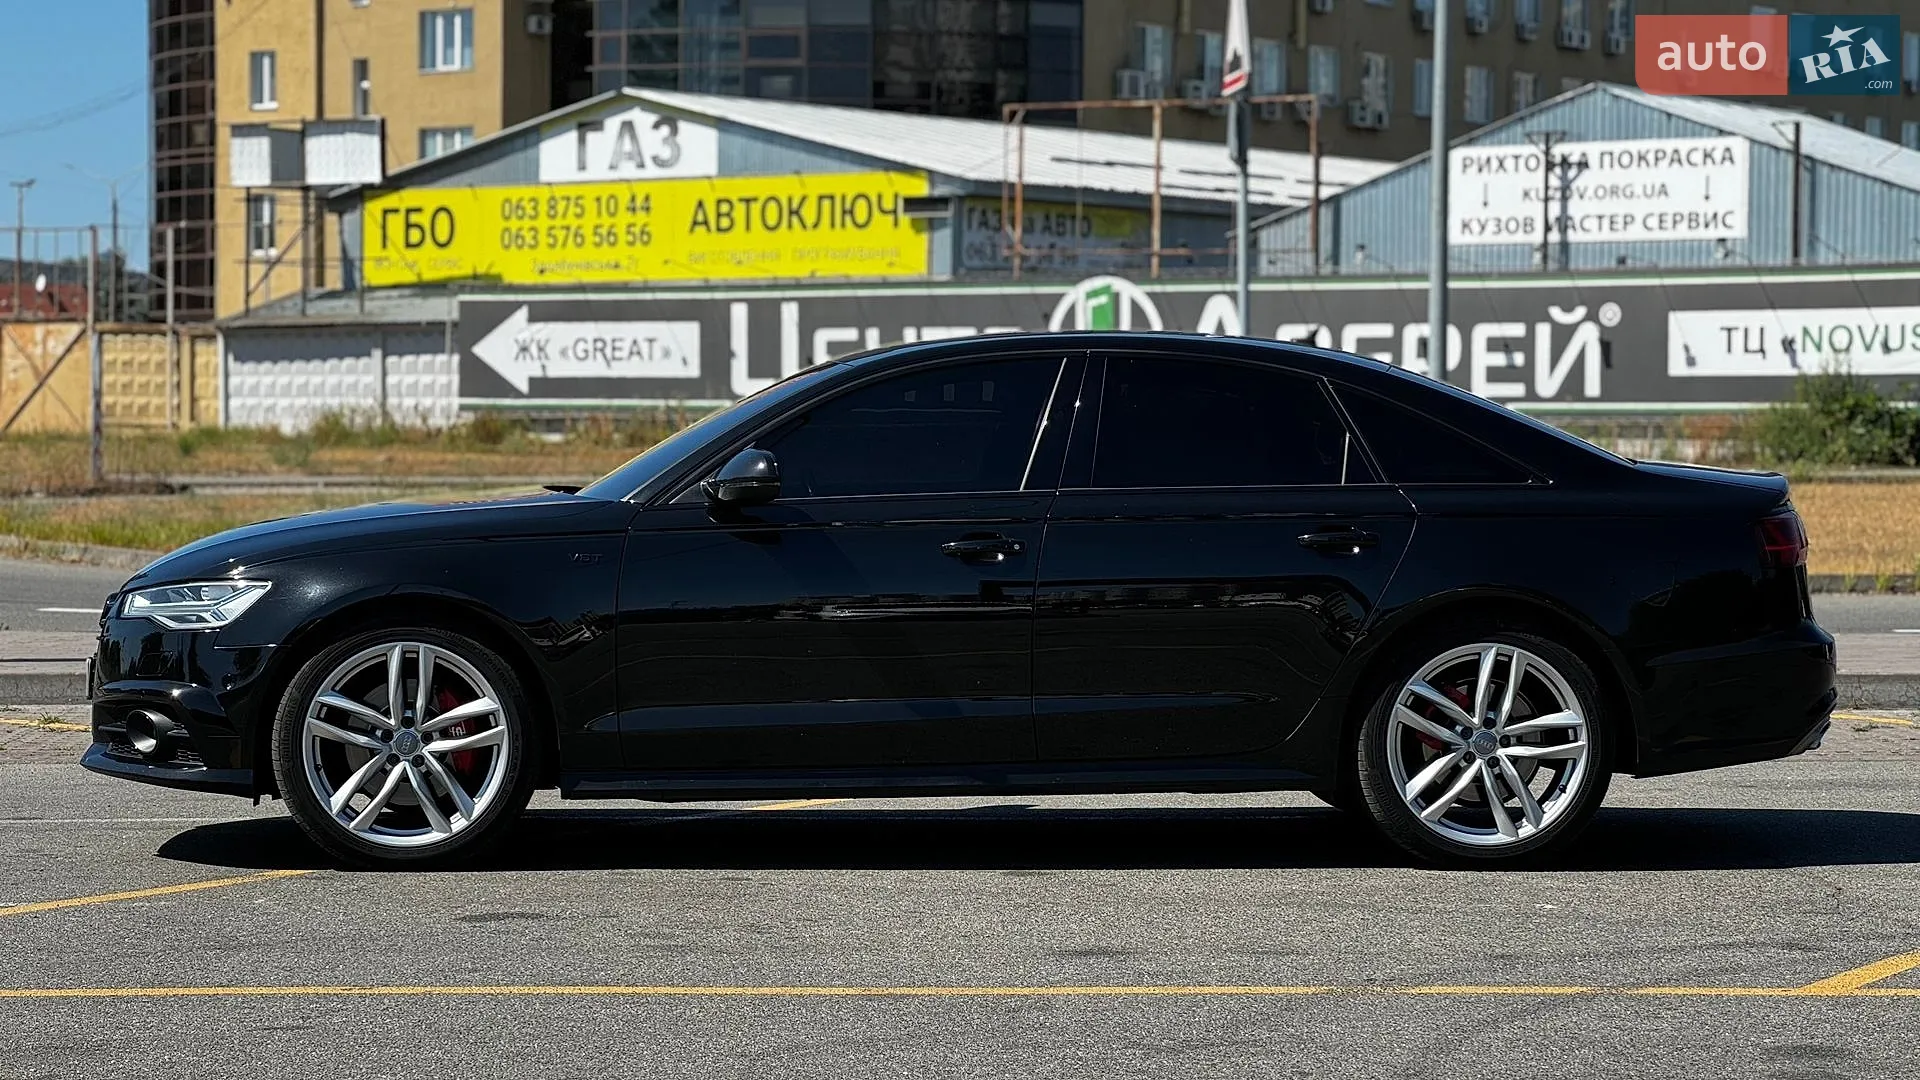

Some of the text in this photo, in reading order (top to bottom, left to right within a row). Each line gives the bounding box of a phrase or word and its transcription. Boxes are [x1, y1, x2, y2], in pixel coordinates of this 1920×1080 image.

[576, 116, 682, 172] ГАЗ
[1600, 146, 1735, 170] ПОКРАСКА
[501, 193, 652, 221] 063 875 10 44
[690, 193, 903, 235] АВТОКЛЮЧ
[379, 206, 456, 250] ГБО
[501, 221, 652, 250] 063 576 56 56
[1461, 216, 1535, 236] КУЗОВ
[1643, 210, 1735, 231] СЕРВИС
[514, 338, 673, 362] ЖК «GREAT»
[1720, 326, 1767, 360] ТЦ
